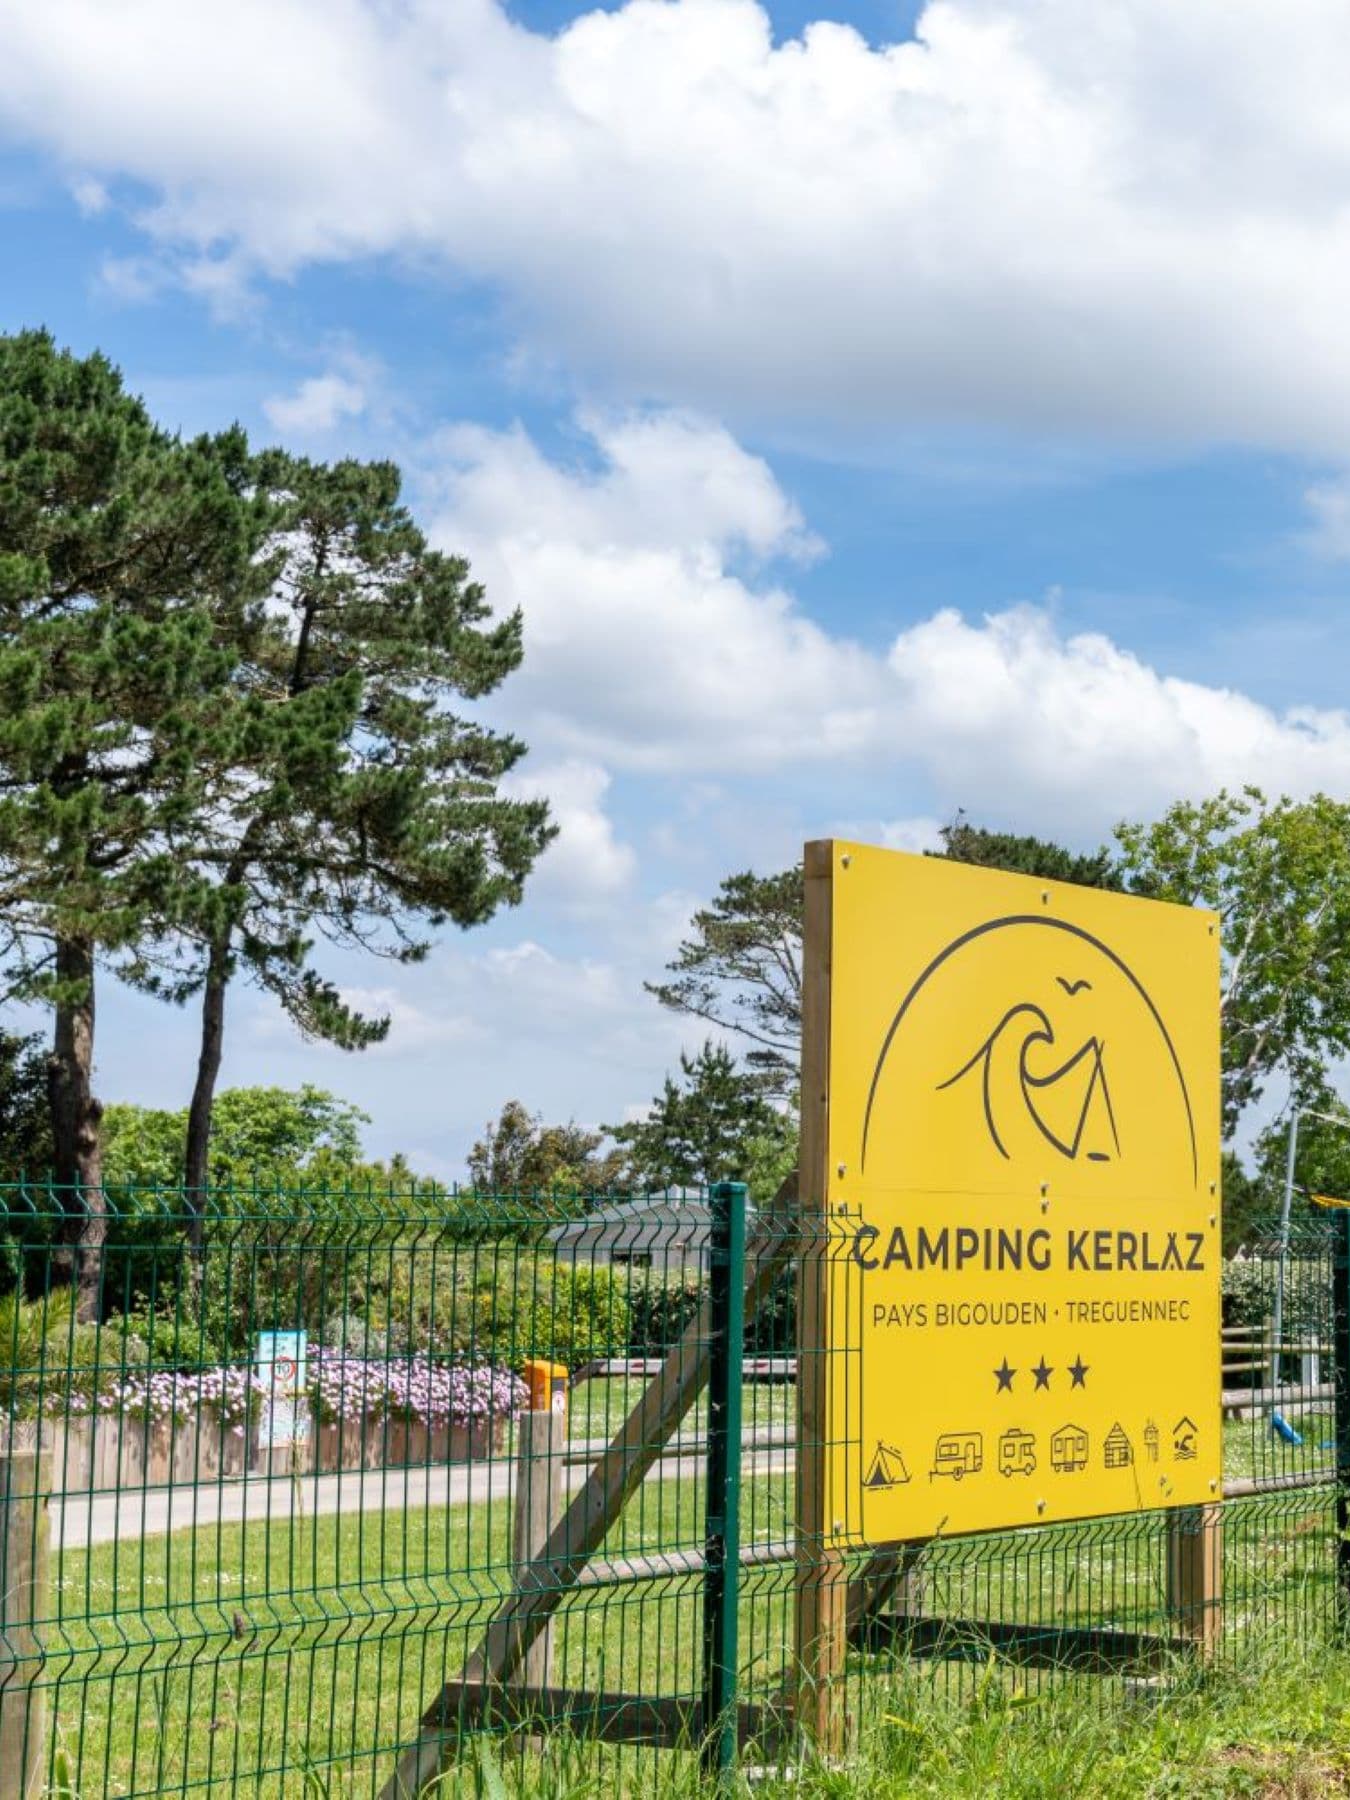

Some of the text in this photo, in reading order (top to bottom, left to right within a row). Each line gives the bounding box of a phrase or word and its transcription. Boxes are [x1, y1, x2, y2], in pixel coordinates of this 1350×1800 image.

[853, 1224, 1052, 1272] CAMPING
[872, 1299, 1191, 1328] PAYS BIGOUDEN TREGUENNEC
